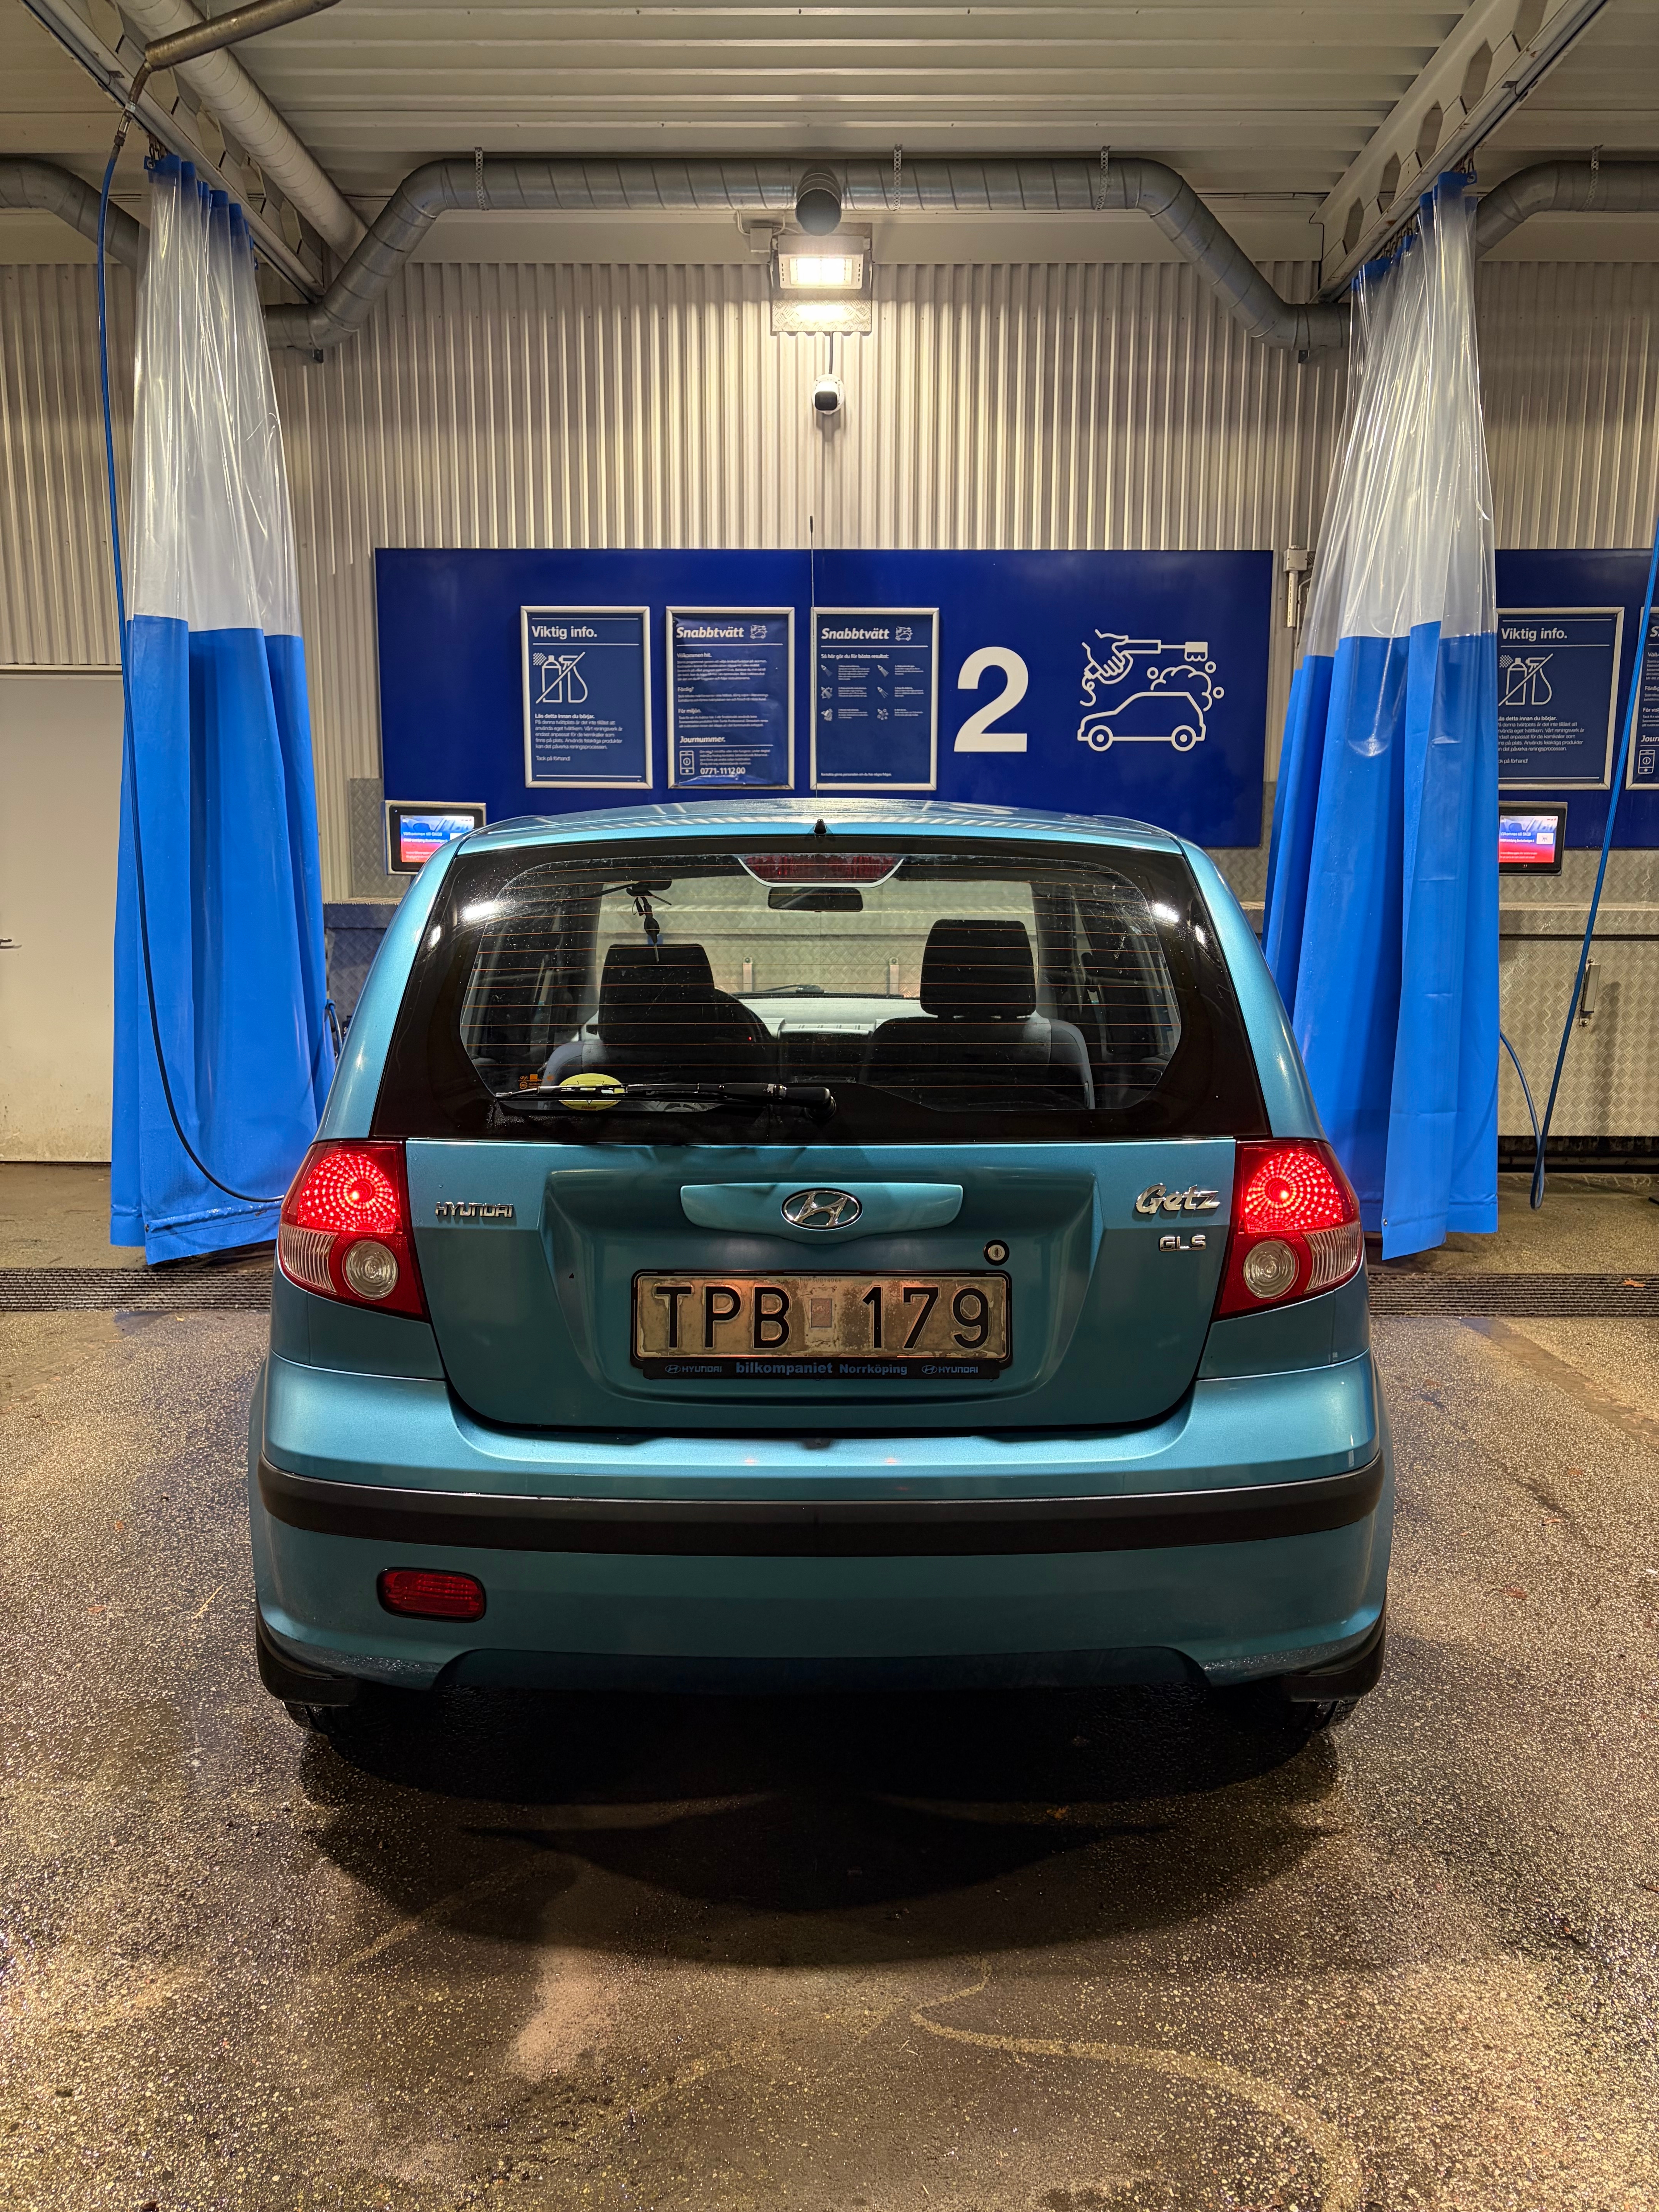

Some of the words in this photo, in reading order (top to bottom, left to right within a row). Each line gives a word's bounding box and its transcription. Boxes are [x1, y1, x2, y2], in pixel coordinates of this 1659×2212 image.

[531, 625, 567, 640] Viktig
[571, 626, 597, 637] info.
[676, 626, 744, 638] Snabbtvätt
[821, 628, 890, 639] Snabbtvätt
[1501, 628, 1537, 642] Viktig
[1540, 628, 1567, 639] info.
[954, 646, 1029, 752] 2
[1136, 1183, 1221, 1214] Getz
[435, 1202, 513, 1217] HYUNDAI
[1160, 1235, 1206, 1252] GLS
[656, 1286, 790, 1349] TPB
[862, 1286, 990, 1349] 179
[736, 1362, 833, 1375] bilkompaniet
[839, 1363, 907, 1375] Norrköping
